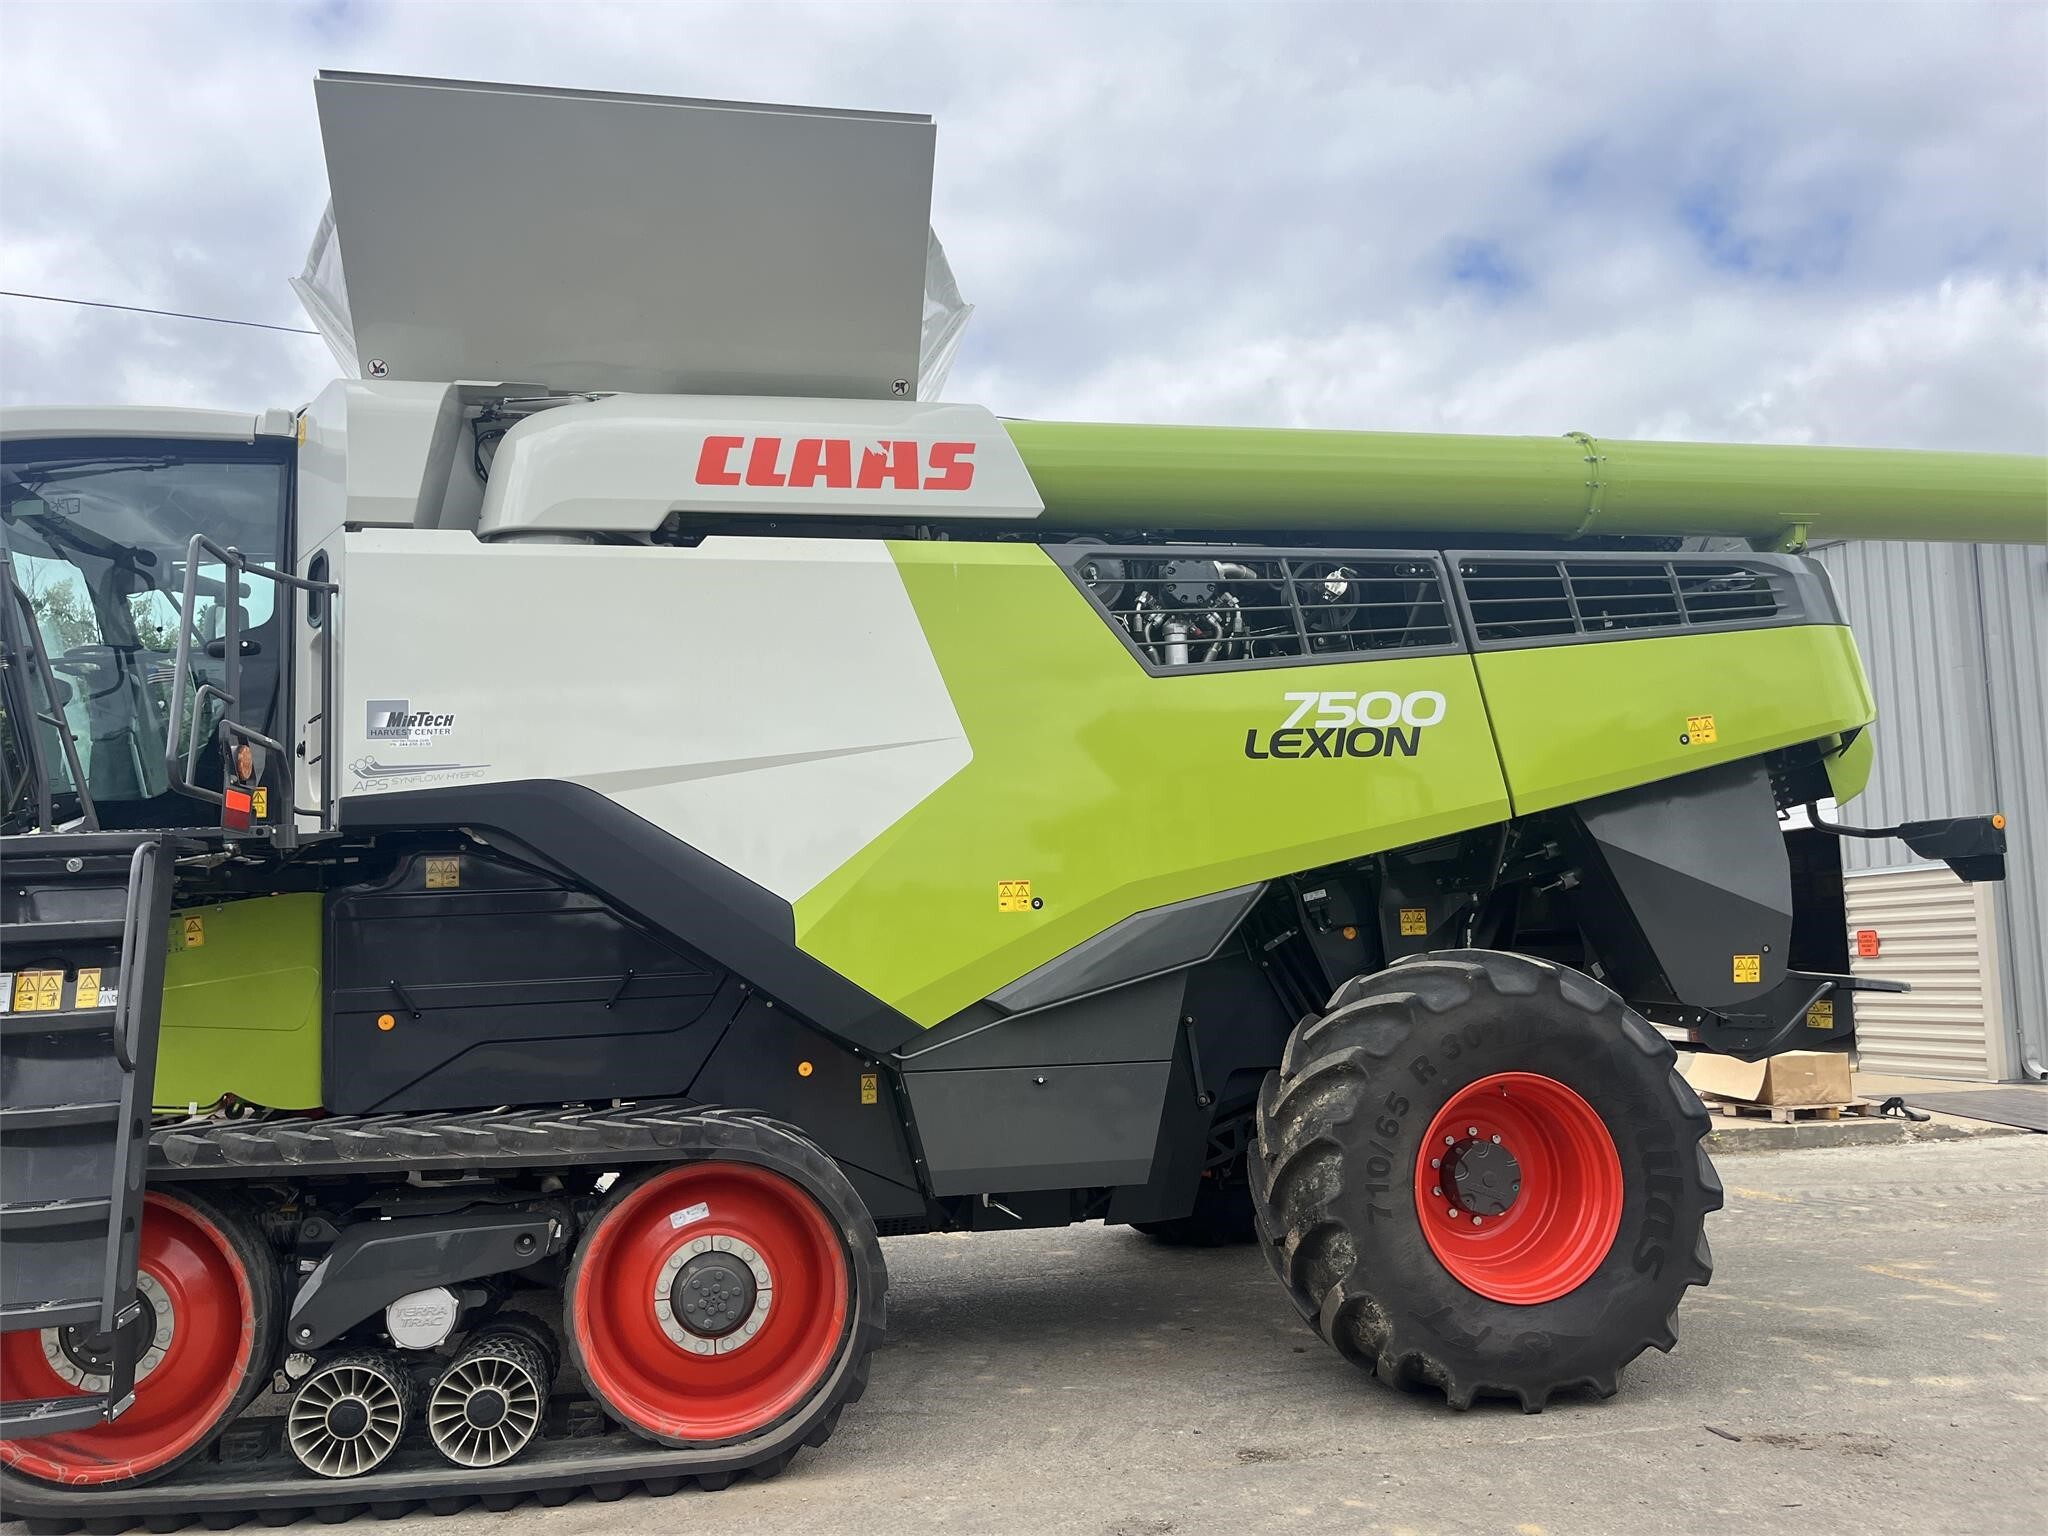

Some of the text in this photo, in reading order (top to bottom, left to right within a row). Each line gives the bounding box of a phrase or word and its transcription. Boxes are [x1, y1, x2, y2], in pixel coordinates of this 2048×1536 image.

[695, 436, 976, 490] CLAAS
[1281, 691, 1446, 729] 7500
[370, 728, 451, 737] HARVEST CENTER
[1245, 727, 1421, 760] LEXION
[352, 769, 485, 792] APS SYNFLOW HYBRID
[1364, 1090, 1410, 1226] 710/65
[1407, 1054, 1439, 1086] R
[396, 1305, 448, 1318] TERRA
[401, 1316, 444, 1328] TRAC
